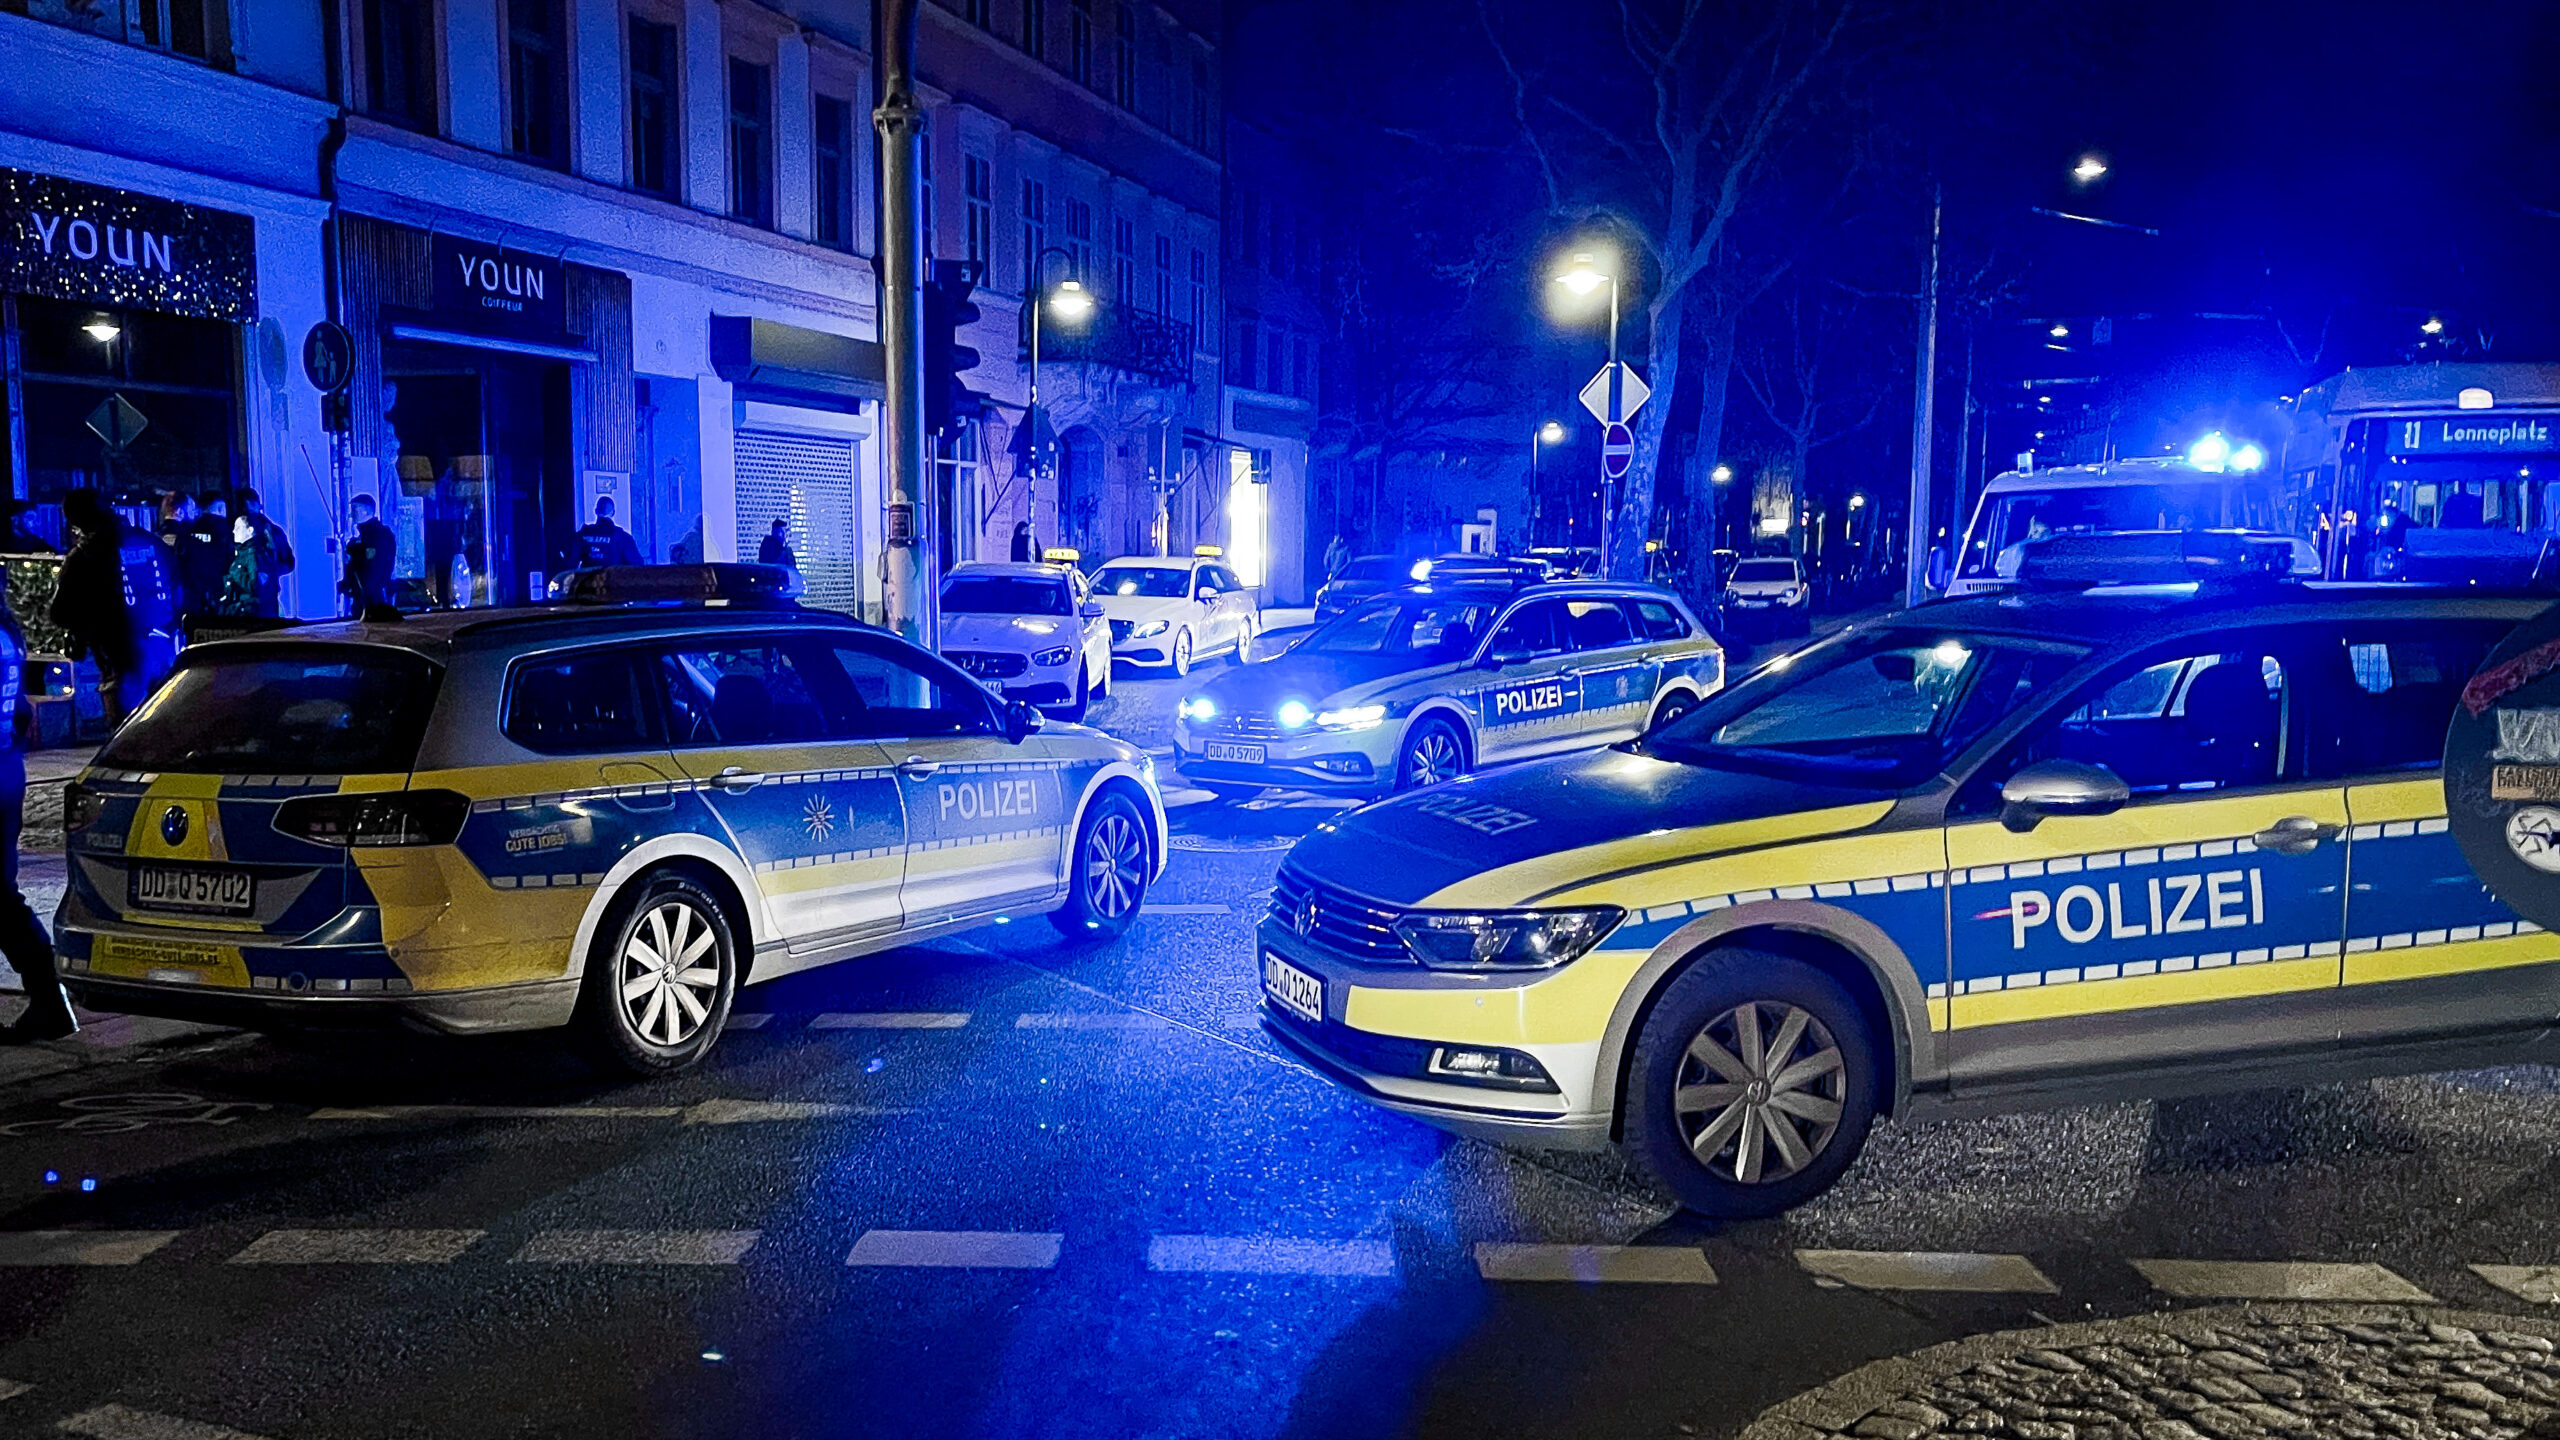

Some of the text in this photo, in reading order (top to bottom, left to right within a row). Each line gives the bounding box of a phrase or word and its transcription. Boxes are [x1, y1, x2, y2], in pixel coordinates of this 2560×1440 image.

[32, 212, 171, 273] YOUN
[458, 252, 544, 301] YOUN
[1496, 684, 1563, 717] POLIZEI
[938, 779, 1038, 821] POLIZEI
[505, 837, 537, 852] GUTE
[141, 869, 165, 898] DD
[197, 873, 248, 904] 5702
[2010, 868, 2264, 949] POLIZEI
[1293, 974, 1319, 1015] 1264
